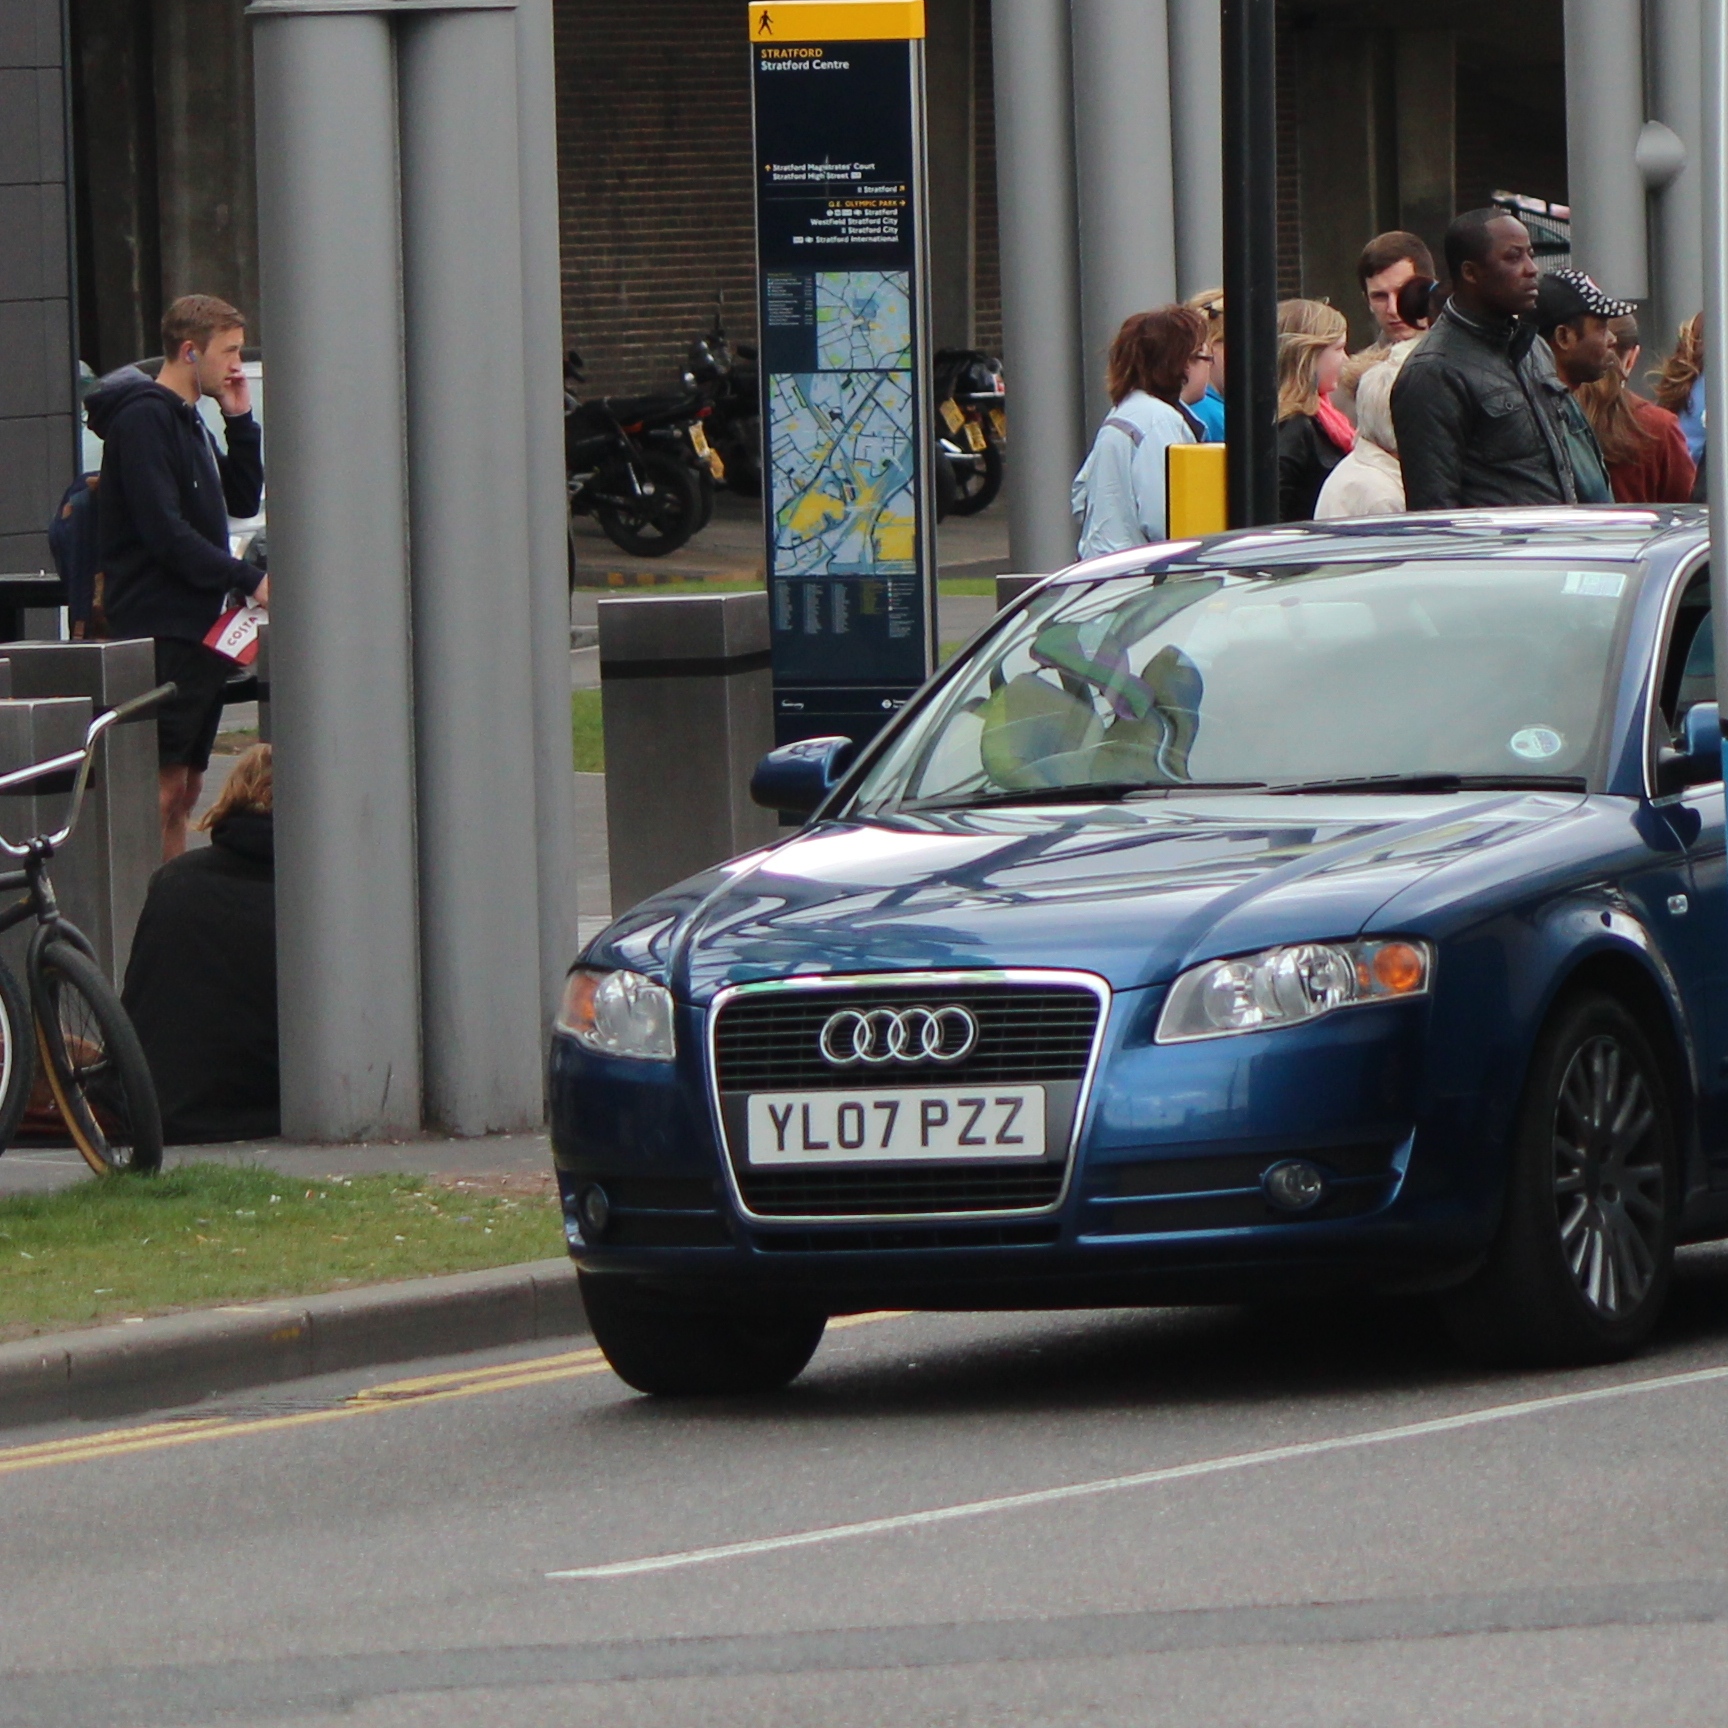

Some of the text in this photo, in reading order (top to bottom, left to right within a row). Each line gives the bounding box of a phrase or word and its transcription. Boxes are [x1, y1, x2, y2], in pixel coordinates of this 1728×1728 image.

[761, 48, 823, 59] STRATFORD
[761, 59, 850, 71] Stratford Centre
[227, 616, 258, 646] COSTA
[768, 1096, 1025, 1152] YL07 PZZ
